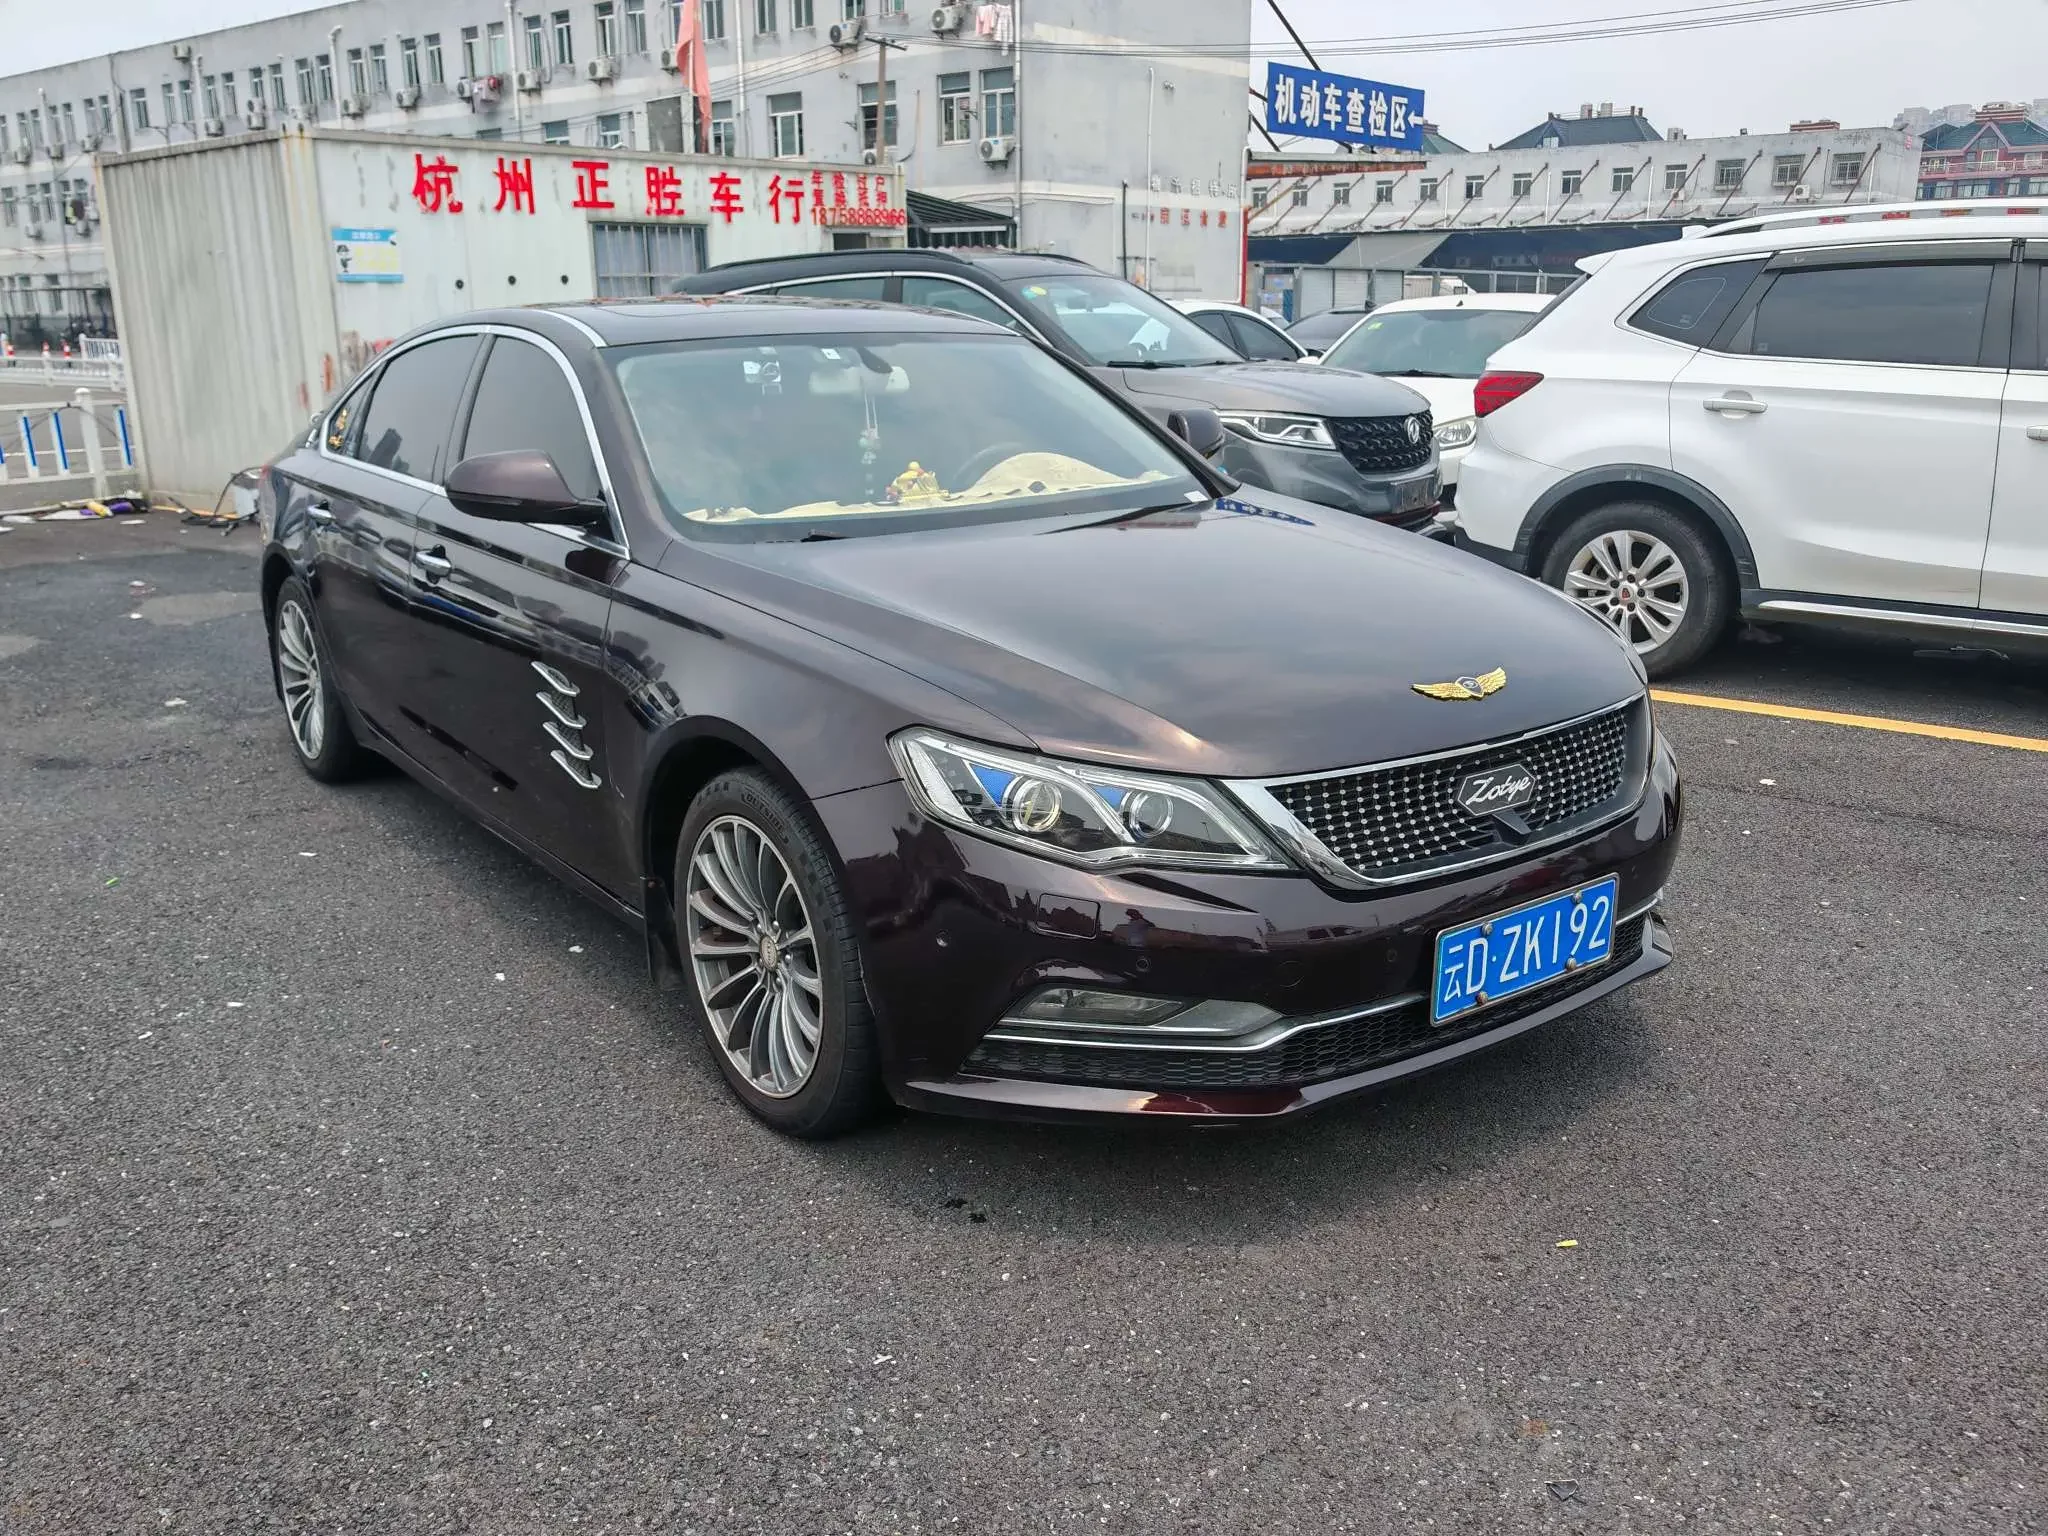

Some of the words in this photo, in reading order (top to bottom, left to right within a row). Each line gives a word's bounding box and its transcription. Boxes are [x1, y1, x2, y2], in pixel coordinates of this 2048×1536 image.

[1275, 74, 1408, 138] 机动车查检区
[412, 153, 804, 224] 杭州正胜车行
[1465, 775, 1531, 805] Zotye
